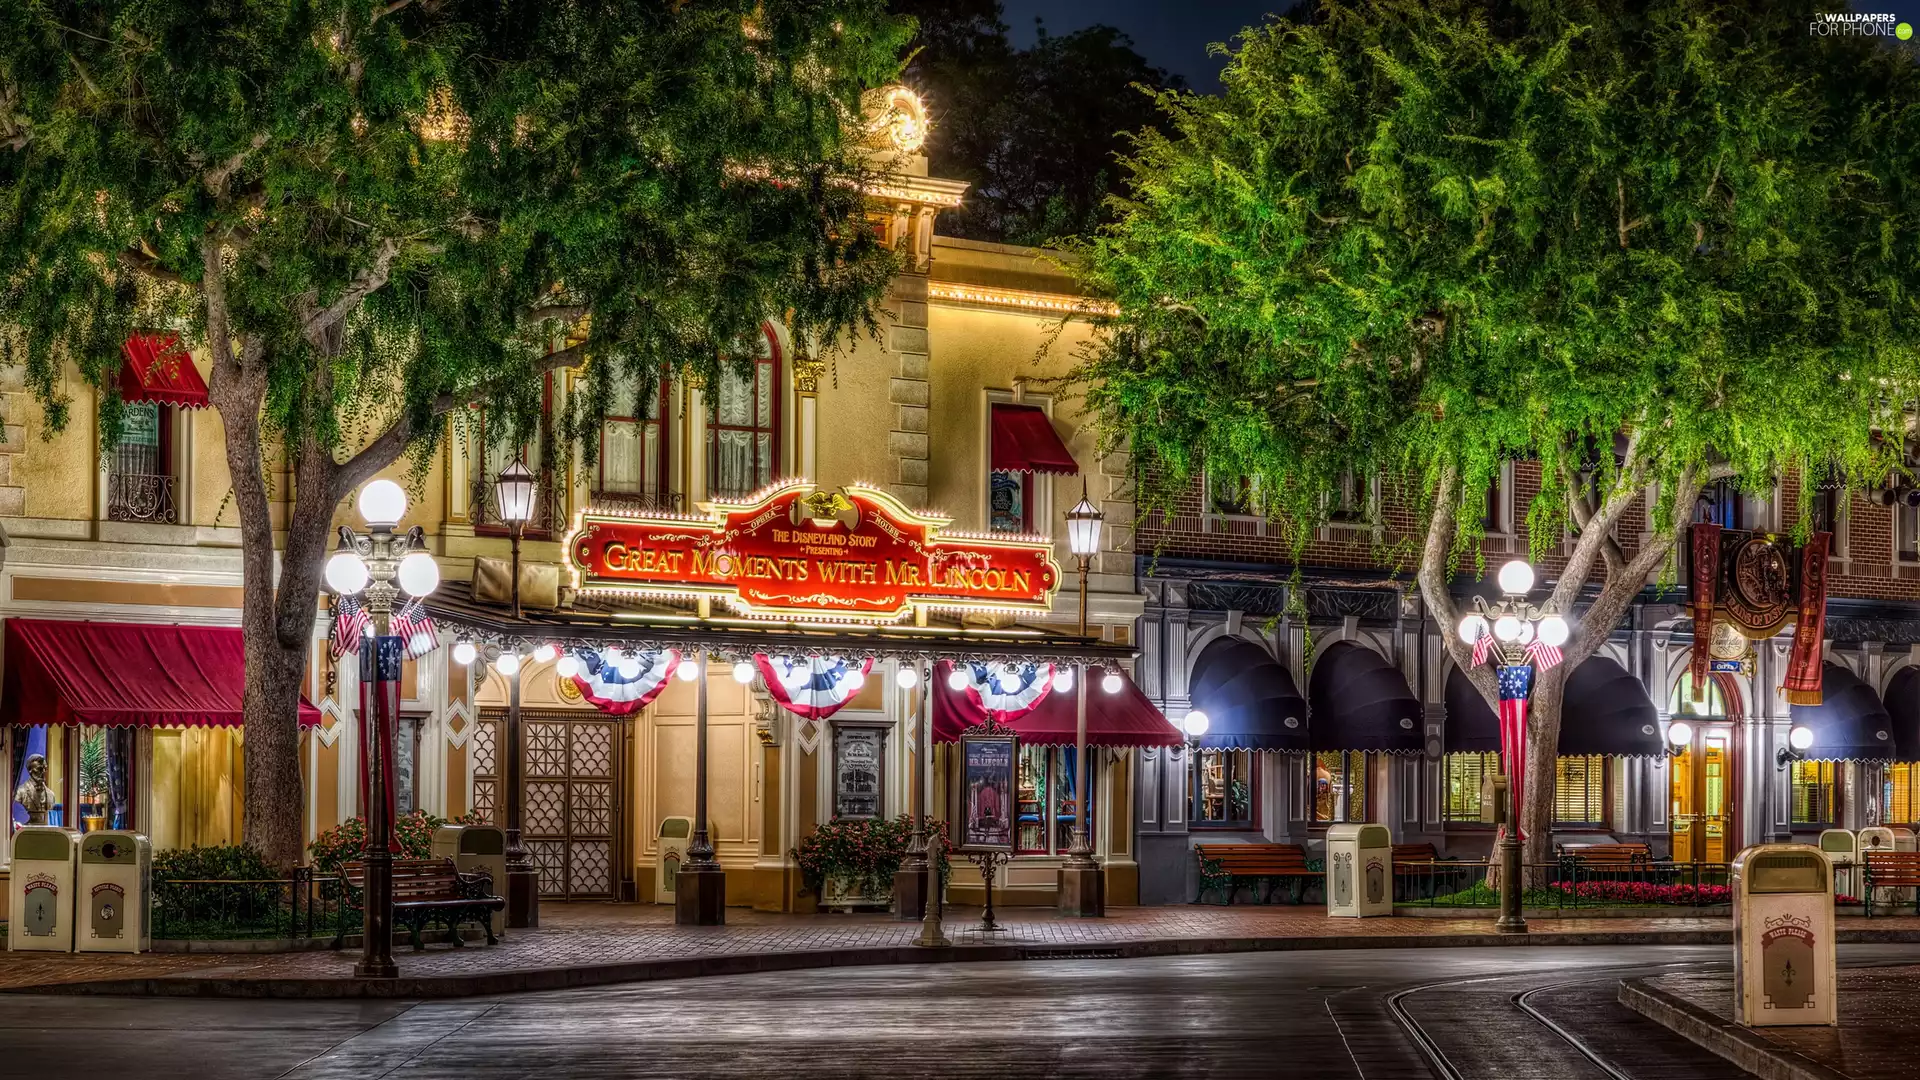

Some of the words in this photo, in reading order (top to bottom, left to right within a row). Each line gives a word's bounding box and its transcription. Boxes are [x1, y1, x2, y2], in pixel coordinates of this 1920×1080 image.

[750, 510, 777, 529] OPERA
[874, 516, 900, 538] HOUSE
[772, 529, 790, 542] THE
[792, 530, 847, 546] DISNEYLAND
[848, 534, 878, 547] STORY
[805, 545, 844, 556] PRESENTING
[603, 543, 684, 573] GREAT
[690, 549, 809, 581] MOMENTS
[816, 560, 877, 585] WITH
[884, 558, 926, 587] MR.
[931, 561, 1031, 593] LINCOLN
[41, 882, 57, 892] PLEASE
[1768, 928, 1787, 938] WASTE
[1788, 928, 1808, 938] PLEASE
